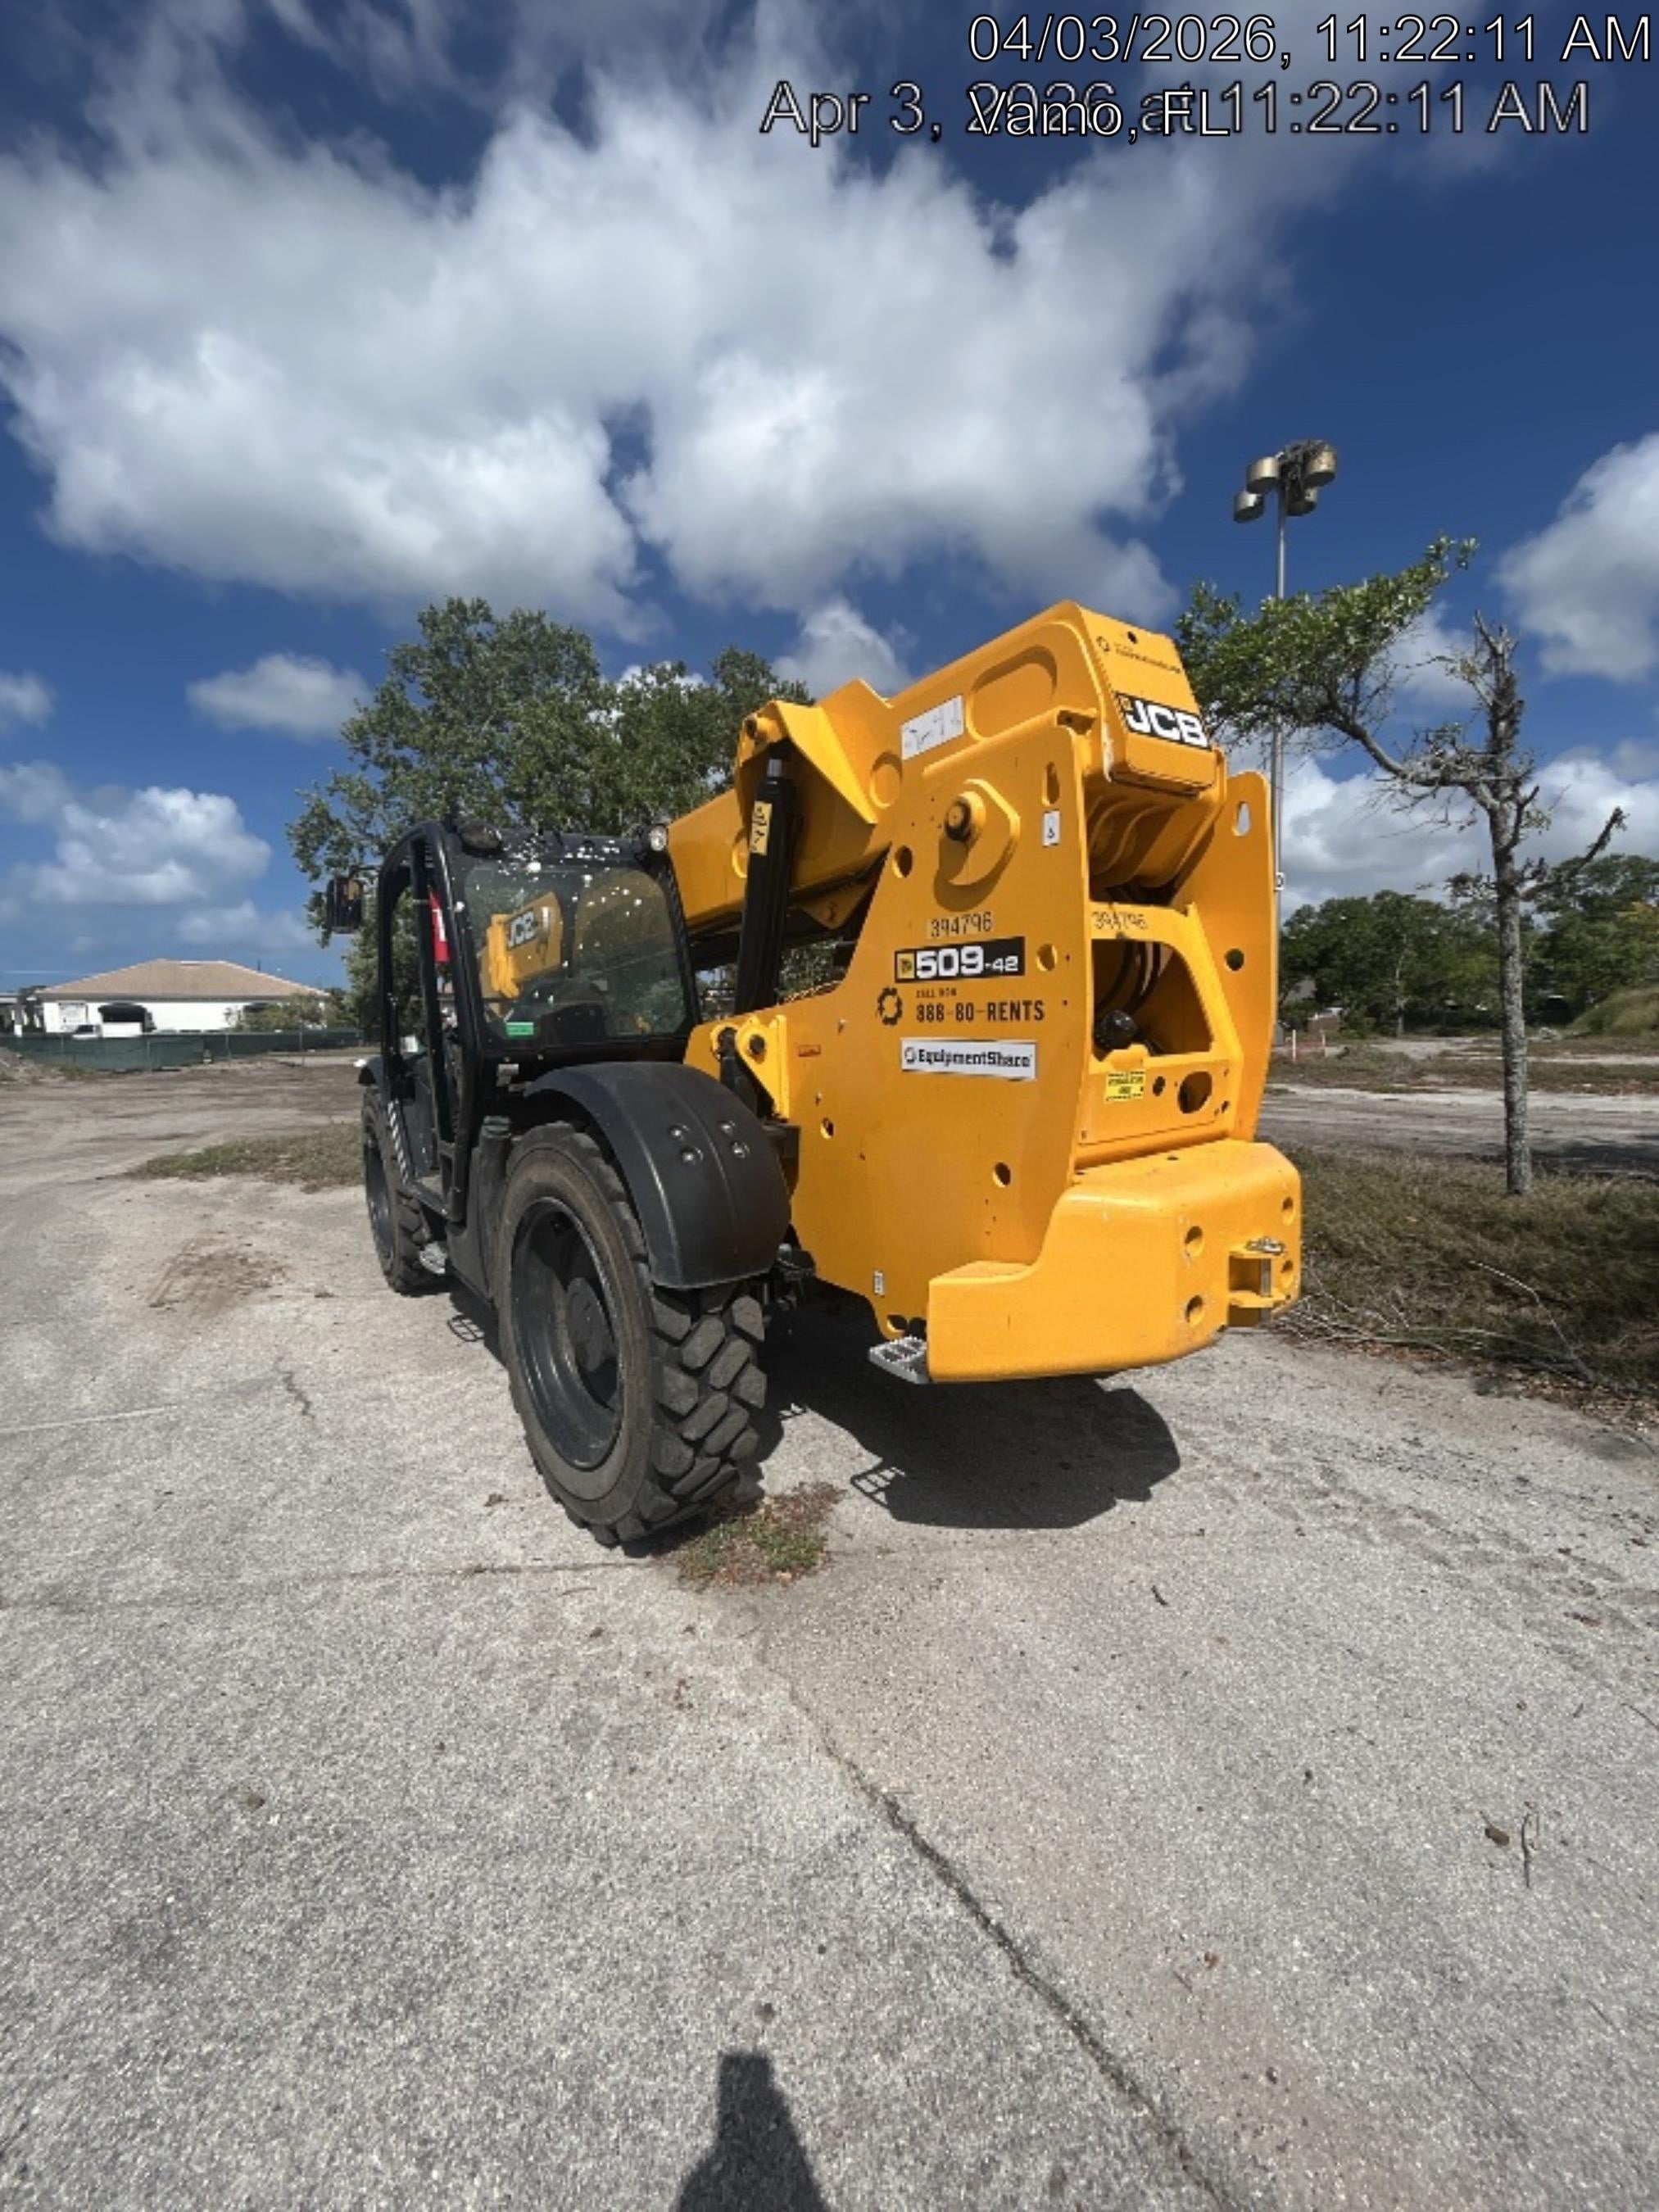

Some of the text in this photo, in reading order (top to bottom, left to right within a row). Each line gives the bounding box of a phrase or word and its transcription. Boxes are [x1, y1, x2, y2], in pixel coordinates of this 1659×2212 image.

[1126, 700, 1209, 748] JCB
[931, 911, 993, 938] 394796
[916, 945, 1019, 979] 509-42
[918, 1048, 1031, 1068] EquipmentShare
